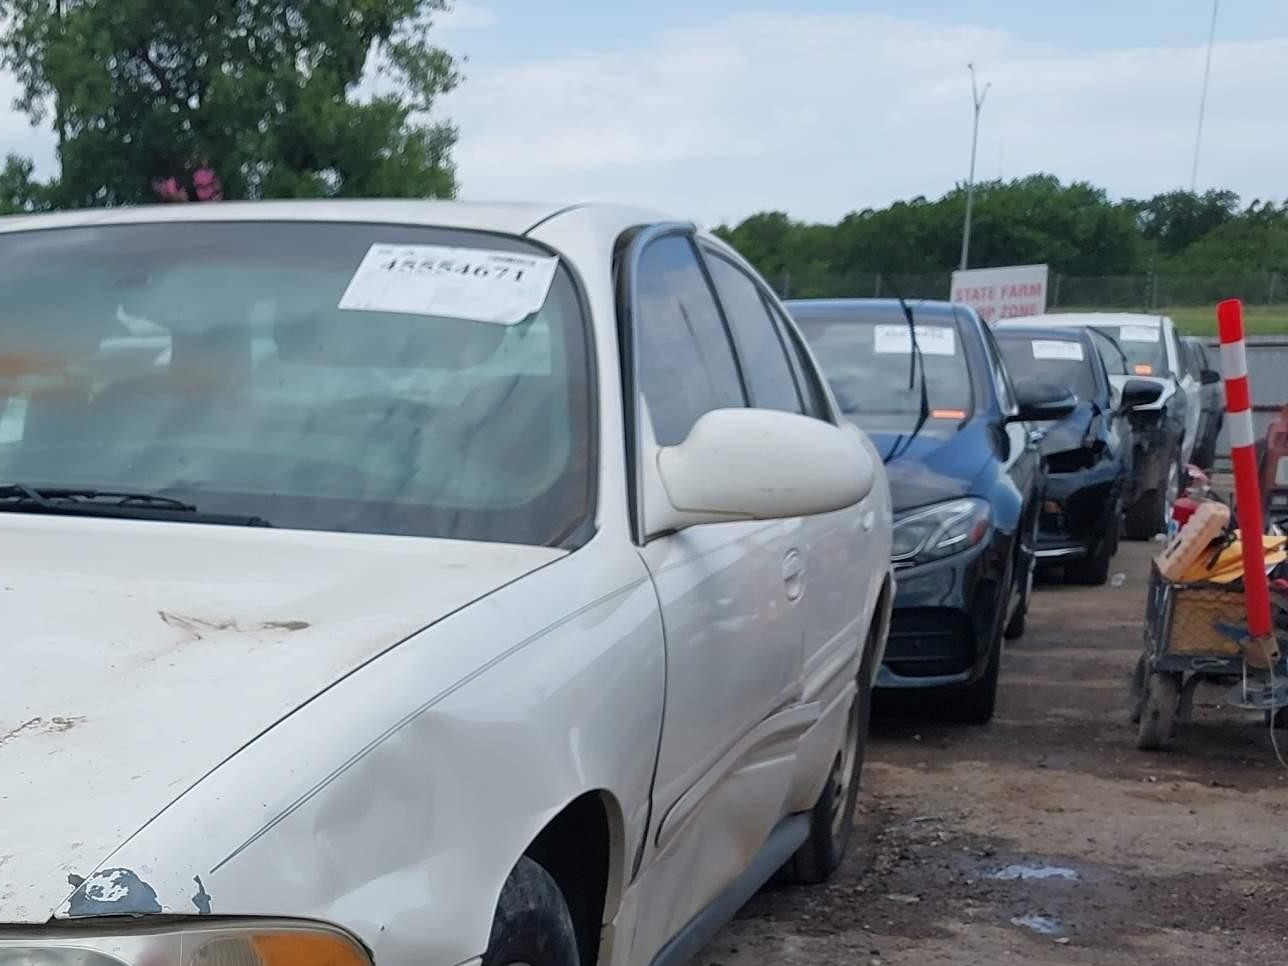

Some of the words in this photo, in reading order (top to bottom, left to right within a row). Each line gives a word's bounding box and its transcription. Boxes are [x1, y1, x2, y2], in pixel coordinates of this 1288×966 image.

[379, 258, 525, 283] 45554671
[955, 286, 995, 302] STATE
[1001, 283, 1041, 298] FARM
[1000, 303, 1037, 318] ZONE
